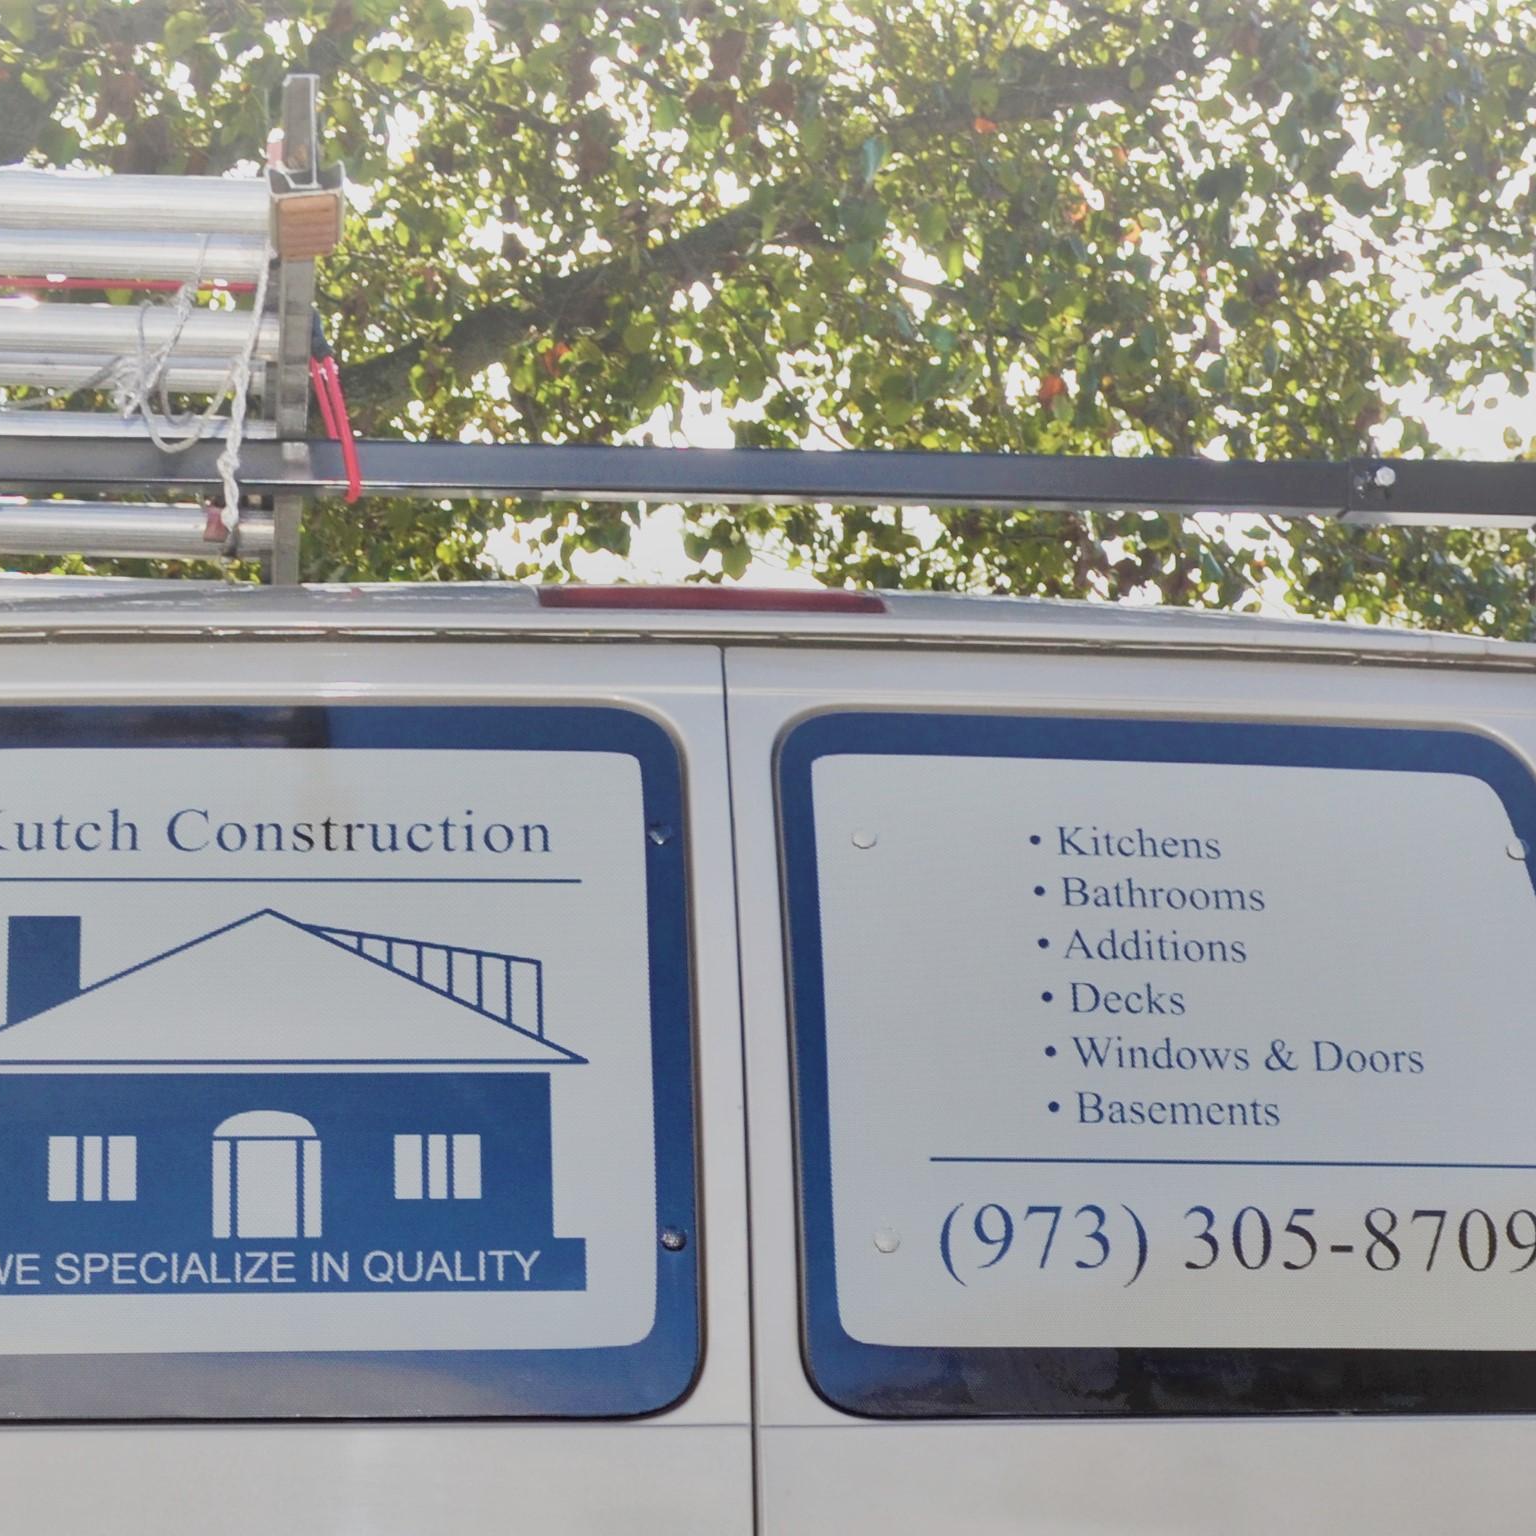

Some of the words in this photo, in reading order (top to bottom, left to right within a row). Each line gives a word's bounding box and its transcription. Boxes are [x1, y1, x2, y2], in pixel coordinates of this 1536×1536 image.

[166, 807, 553, 855] Construction
[1056, 824, 1223, 861] Kitchens
[1061, 875, 1266, 913] Bathrooms
[1063, 927, 1248, 964] Additions
[1069, 981, 1187, 1017] Decks
[1072, 1034, 1251, 1073] Windows
[1263, 1038, 1299, 1073] &
[1312, 1039, 1426, 1076] Doors
[1076, 1090, 1282, 1128] Basements
[938, 1202, 1150, 1288] (973)
[54, 1250, 298, 1286] SPECIALIZE
[310, 1250, 350, 1284] IN
[361, 1249, 542, 1285] QUALITY
